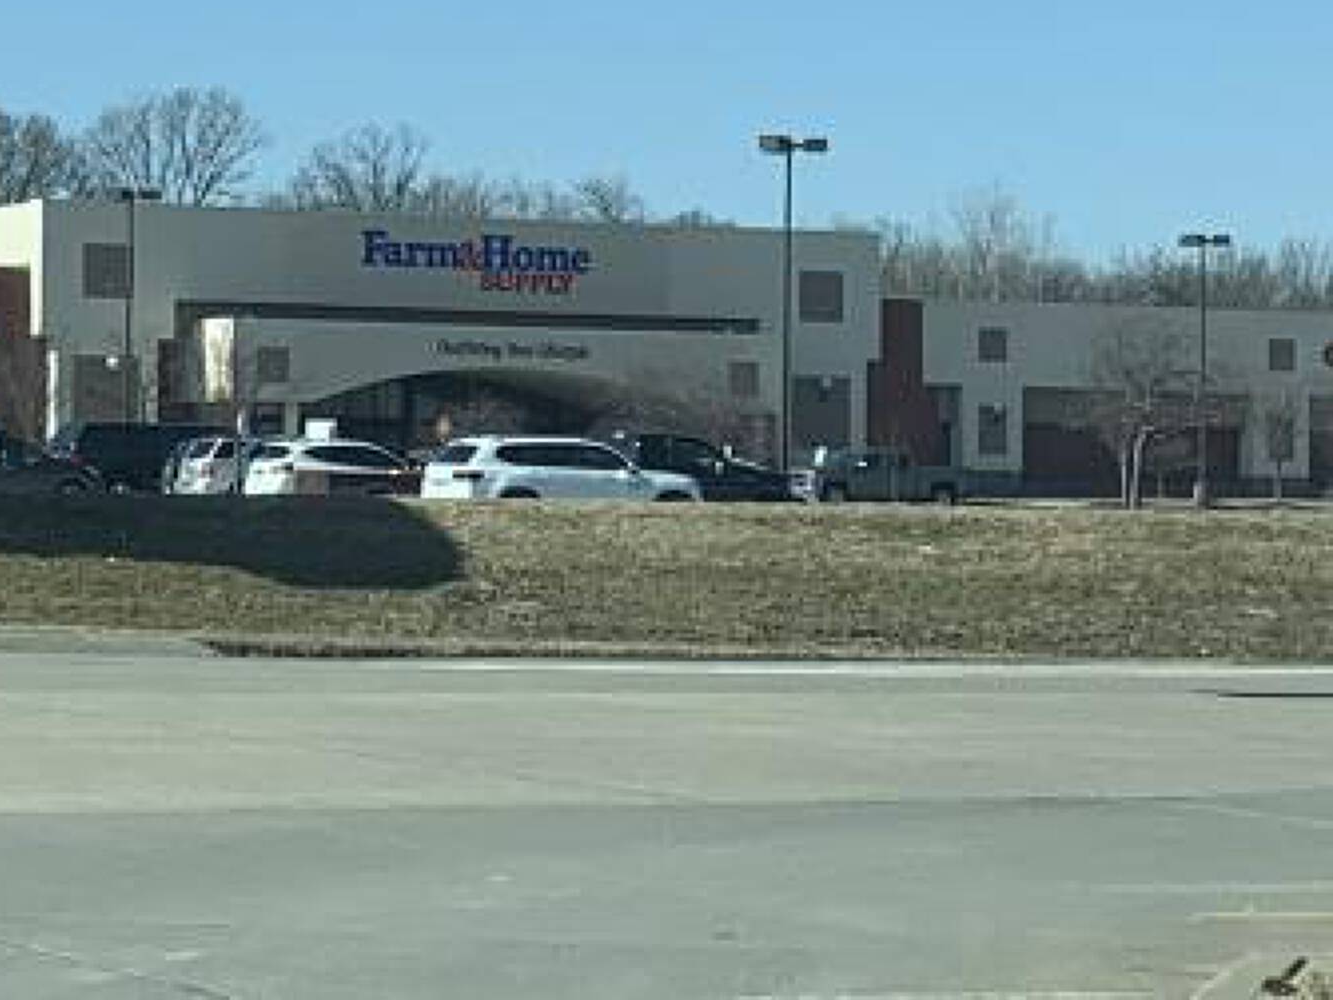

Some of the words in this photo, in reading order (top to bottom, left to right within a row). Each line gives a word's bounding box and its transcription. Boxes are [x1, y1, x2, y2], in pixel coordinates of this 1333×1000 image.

[361, 230, 455, 268] Farm
[481, 233, 591, 274] Home
[479, 273, 577, 295] SUPPLY
